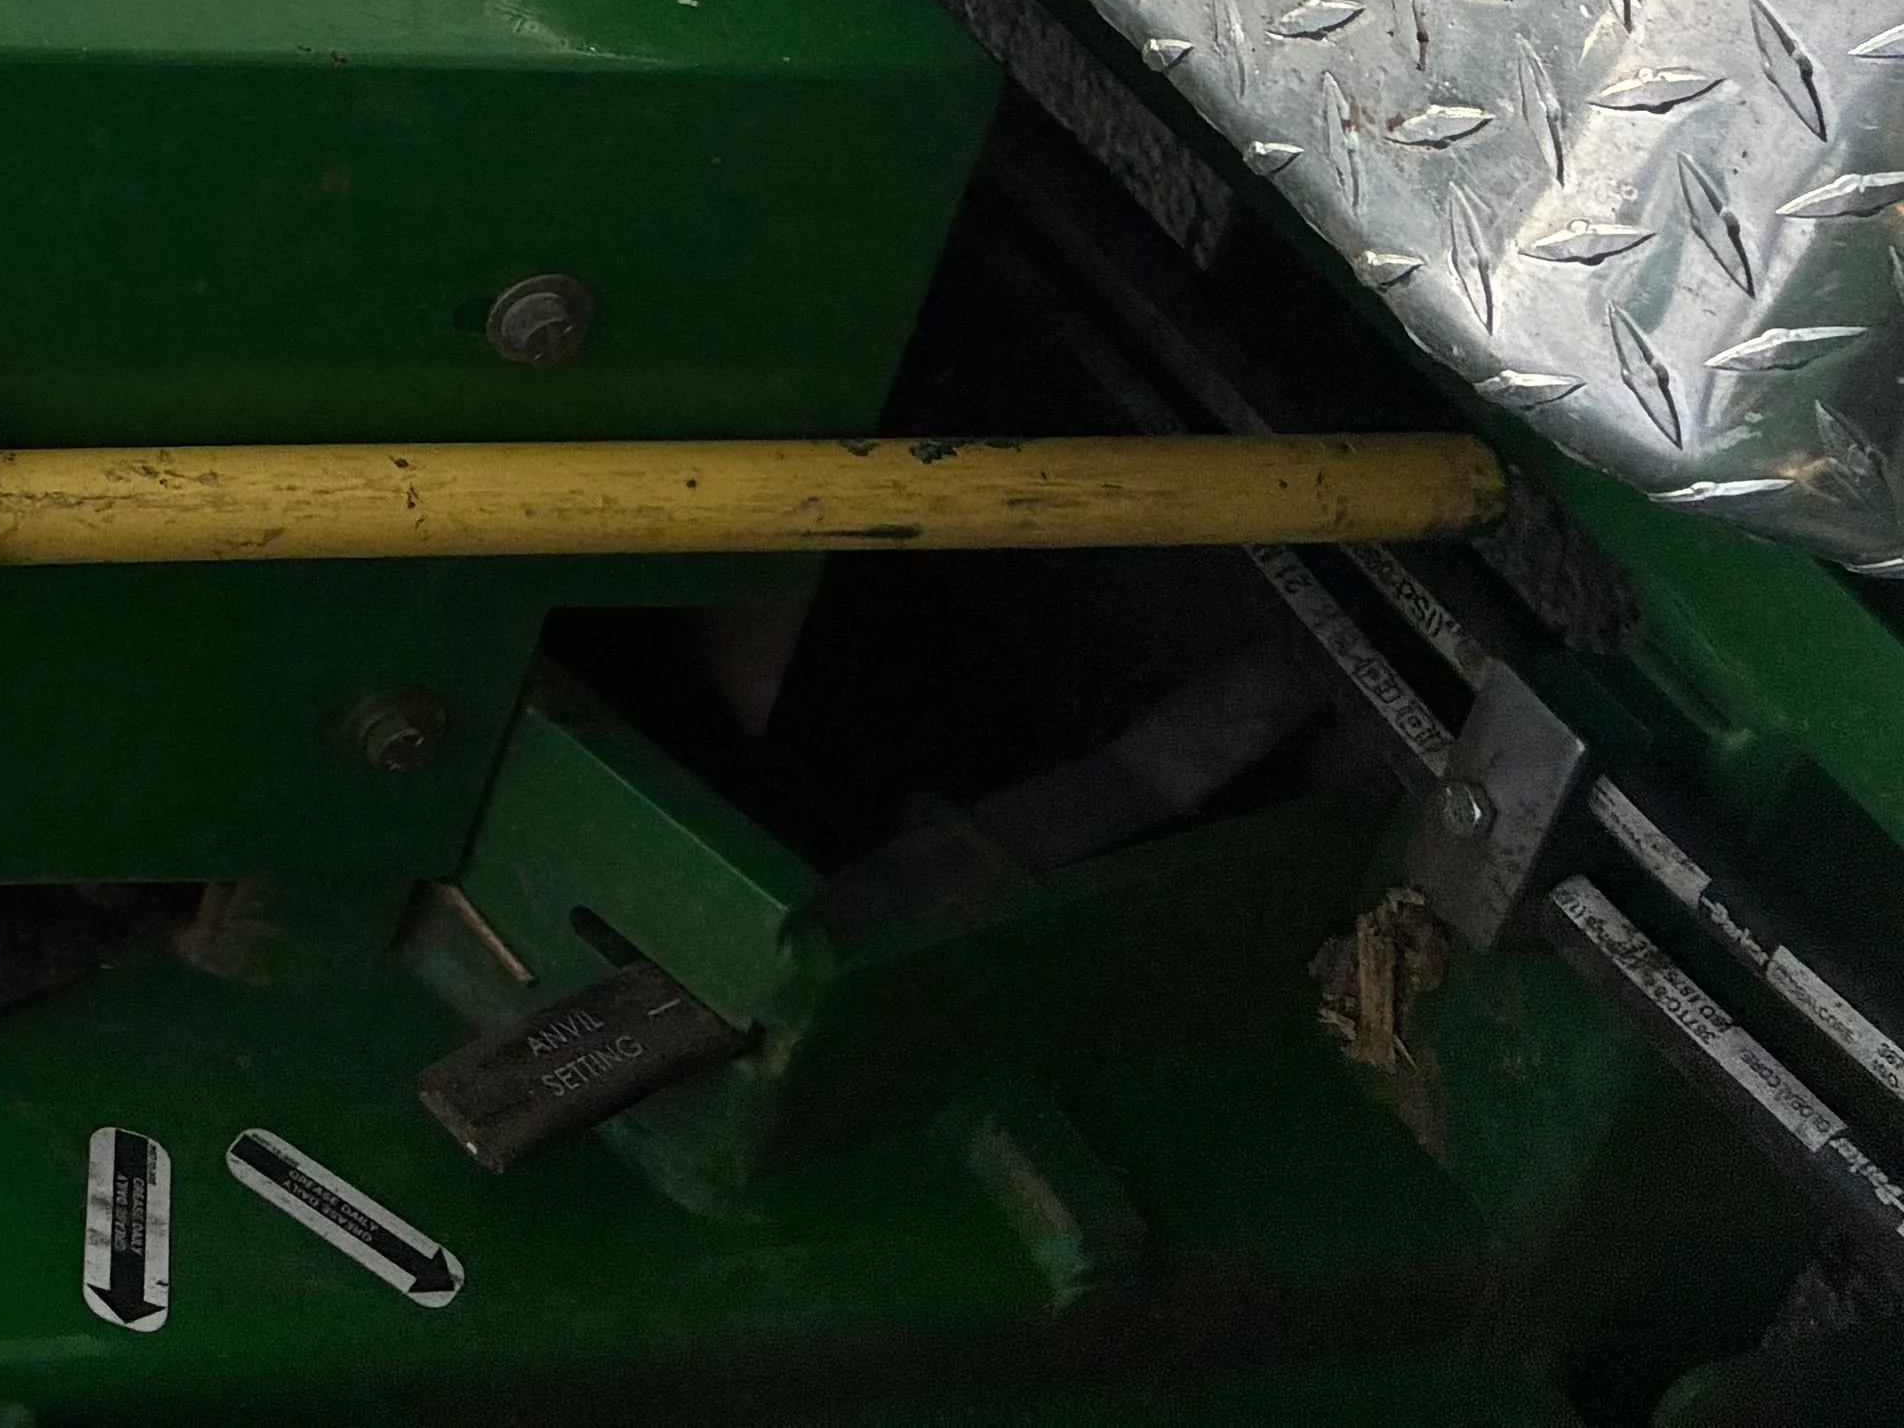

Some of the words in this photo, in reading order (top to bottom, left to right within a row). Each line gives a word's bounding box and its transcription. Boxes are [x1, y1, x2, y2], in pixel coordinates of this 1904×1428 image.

[528, 1010, 604, 1056] ANVIL
[541, 1035, 643, 1096] SETTING
[115, 1174, 128, 1205] DAILY
[281, 1178, 320, 1208] DAILY
[339, 1203, 379, 1233] DAILY
